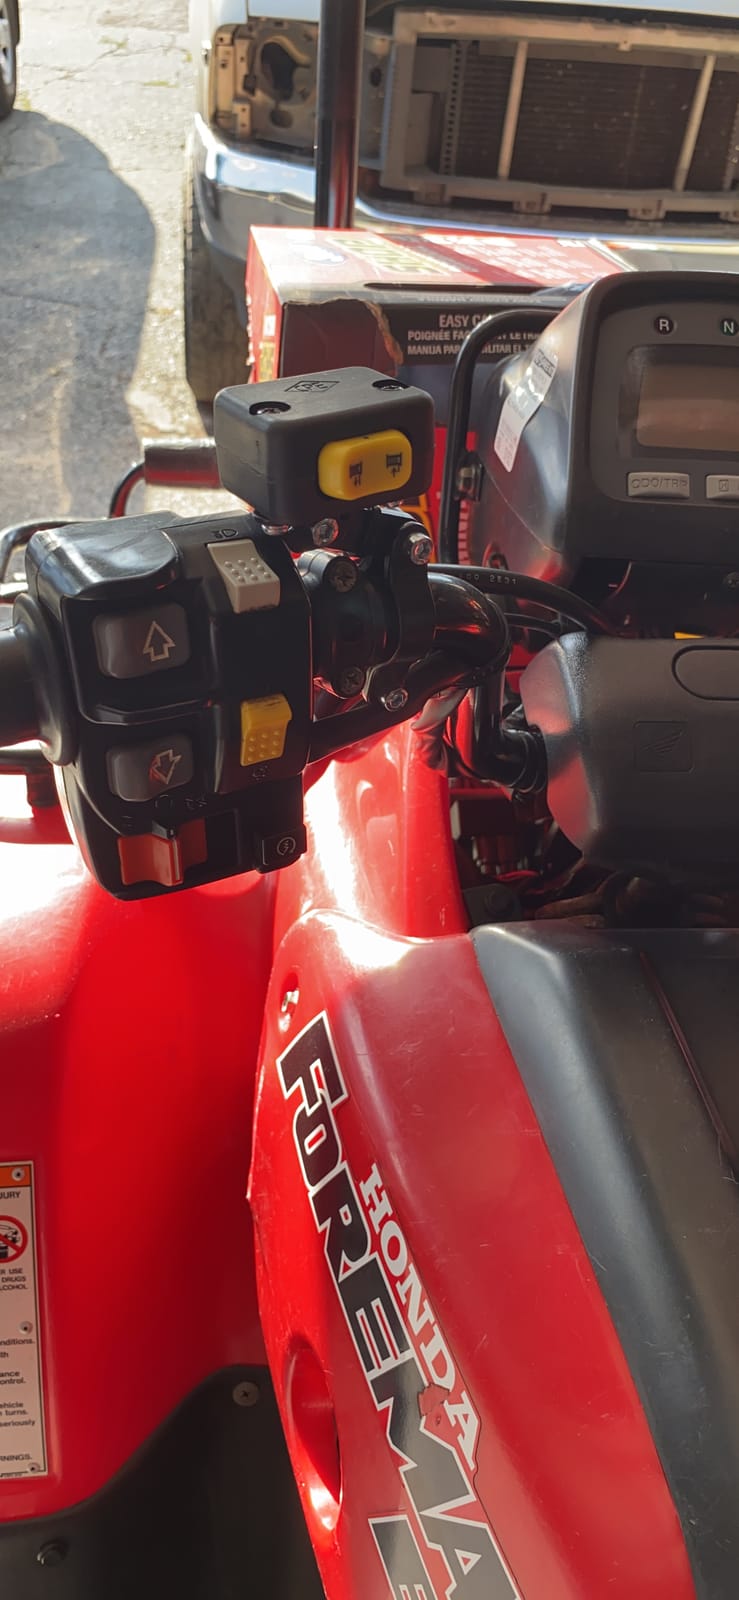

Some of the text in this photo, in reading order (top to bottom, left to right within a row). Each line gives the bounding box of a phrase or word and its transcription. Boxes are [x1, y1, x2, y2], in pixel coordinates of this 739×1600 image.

[439, 314, 470, 327] EASY
[659, 319, 669, 331] R
[723, 321, 734, 334] N
[408, 330, 450, 341] POIGNÉE
[360, 1163, 480, 1472] HONDA
